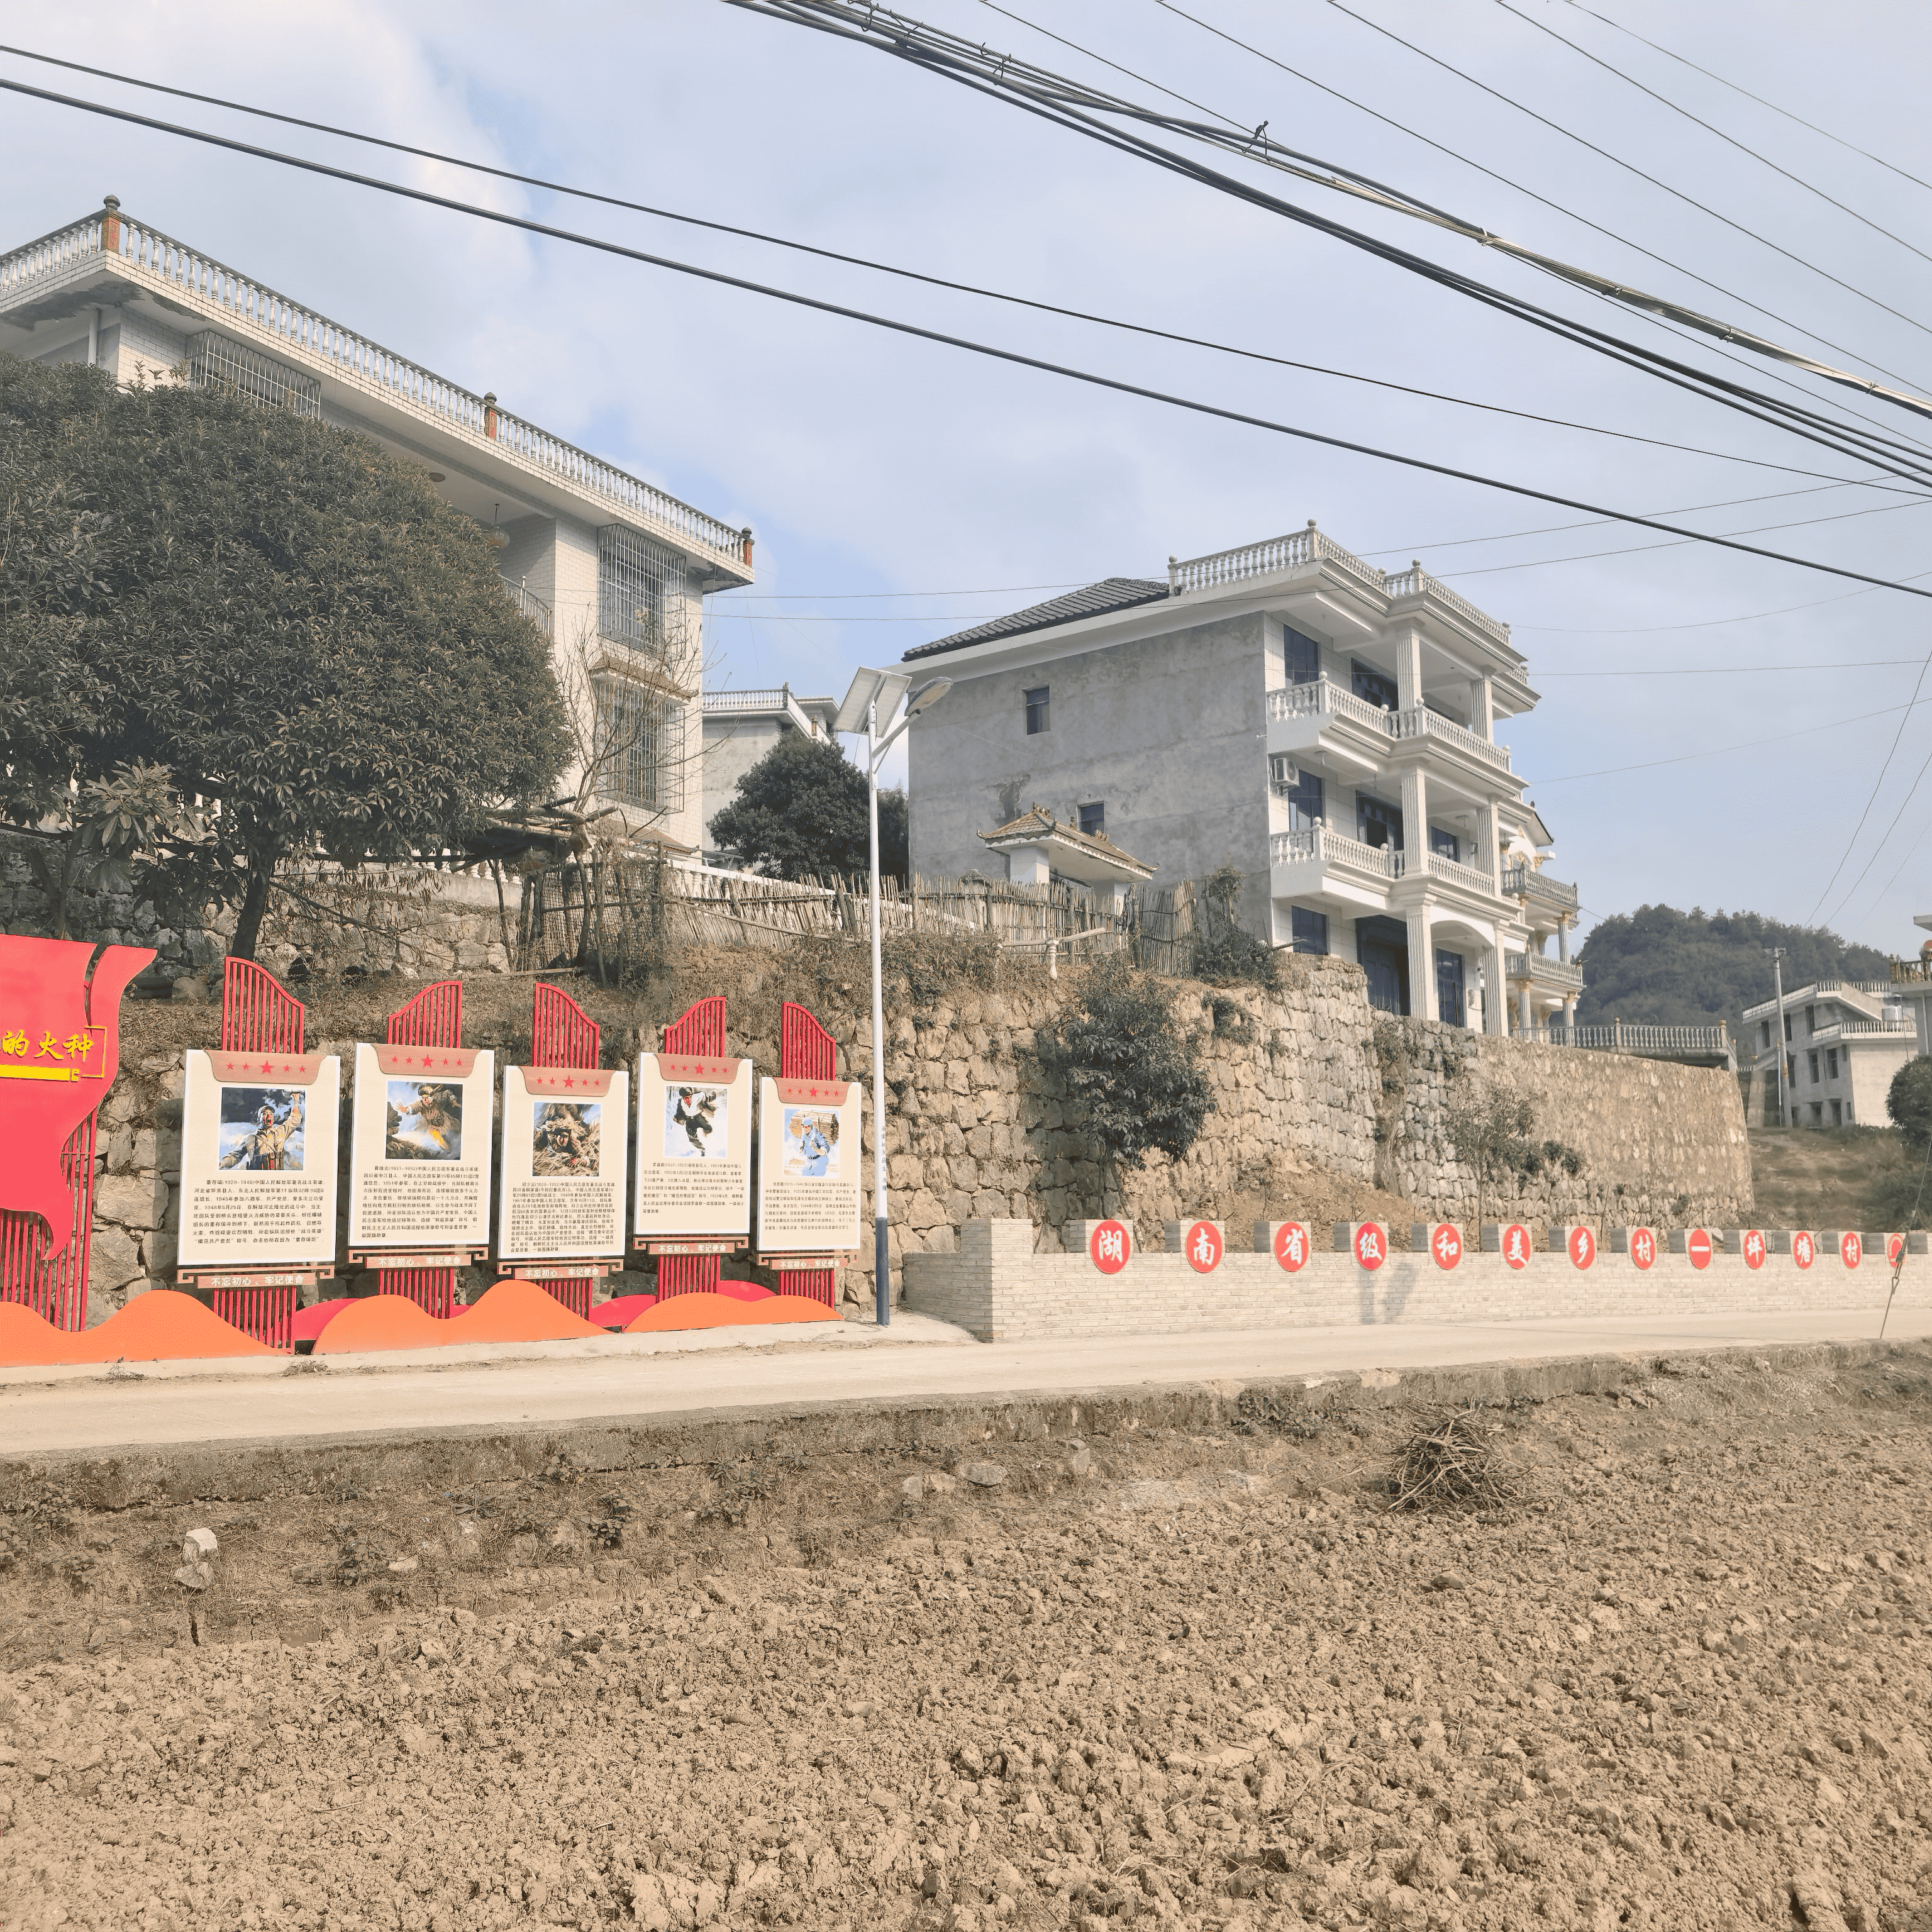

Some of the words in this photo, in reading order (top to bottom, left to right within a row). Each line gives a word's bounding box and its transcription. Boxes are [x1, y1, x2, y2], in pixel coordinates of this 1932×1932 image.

[2, 1030, 93, 1062] 的火种
[659, 1244, 726, 1253] 不忘初心、牢记使命
[379, 1257, 460, 1267] 不忘初心、牢记使命
[780, 1260, 840, 1269] 不忘初心、牢记使命
[525, 1268, 599, 1277] 不忘初心、牢记使命
[211, 1275, 303, 1287] 不忘初心、牢记使命
